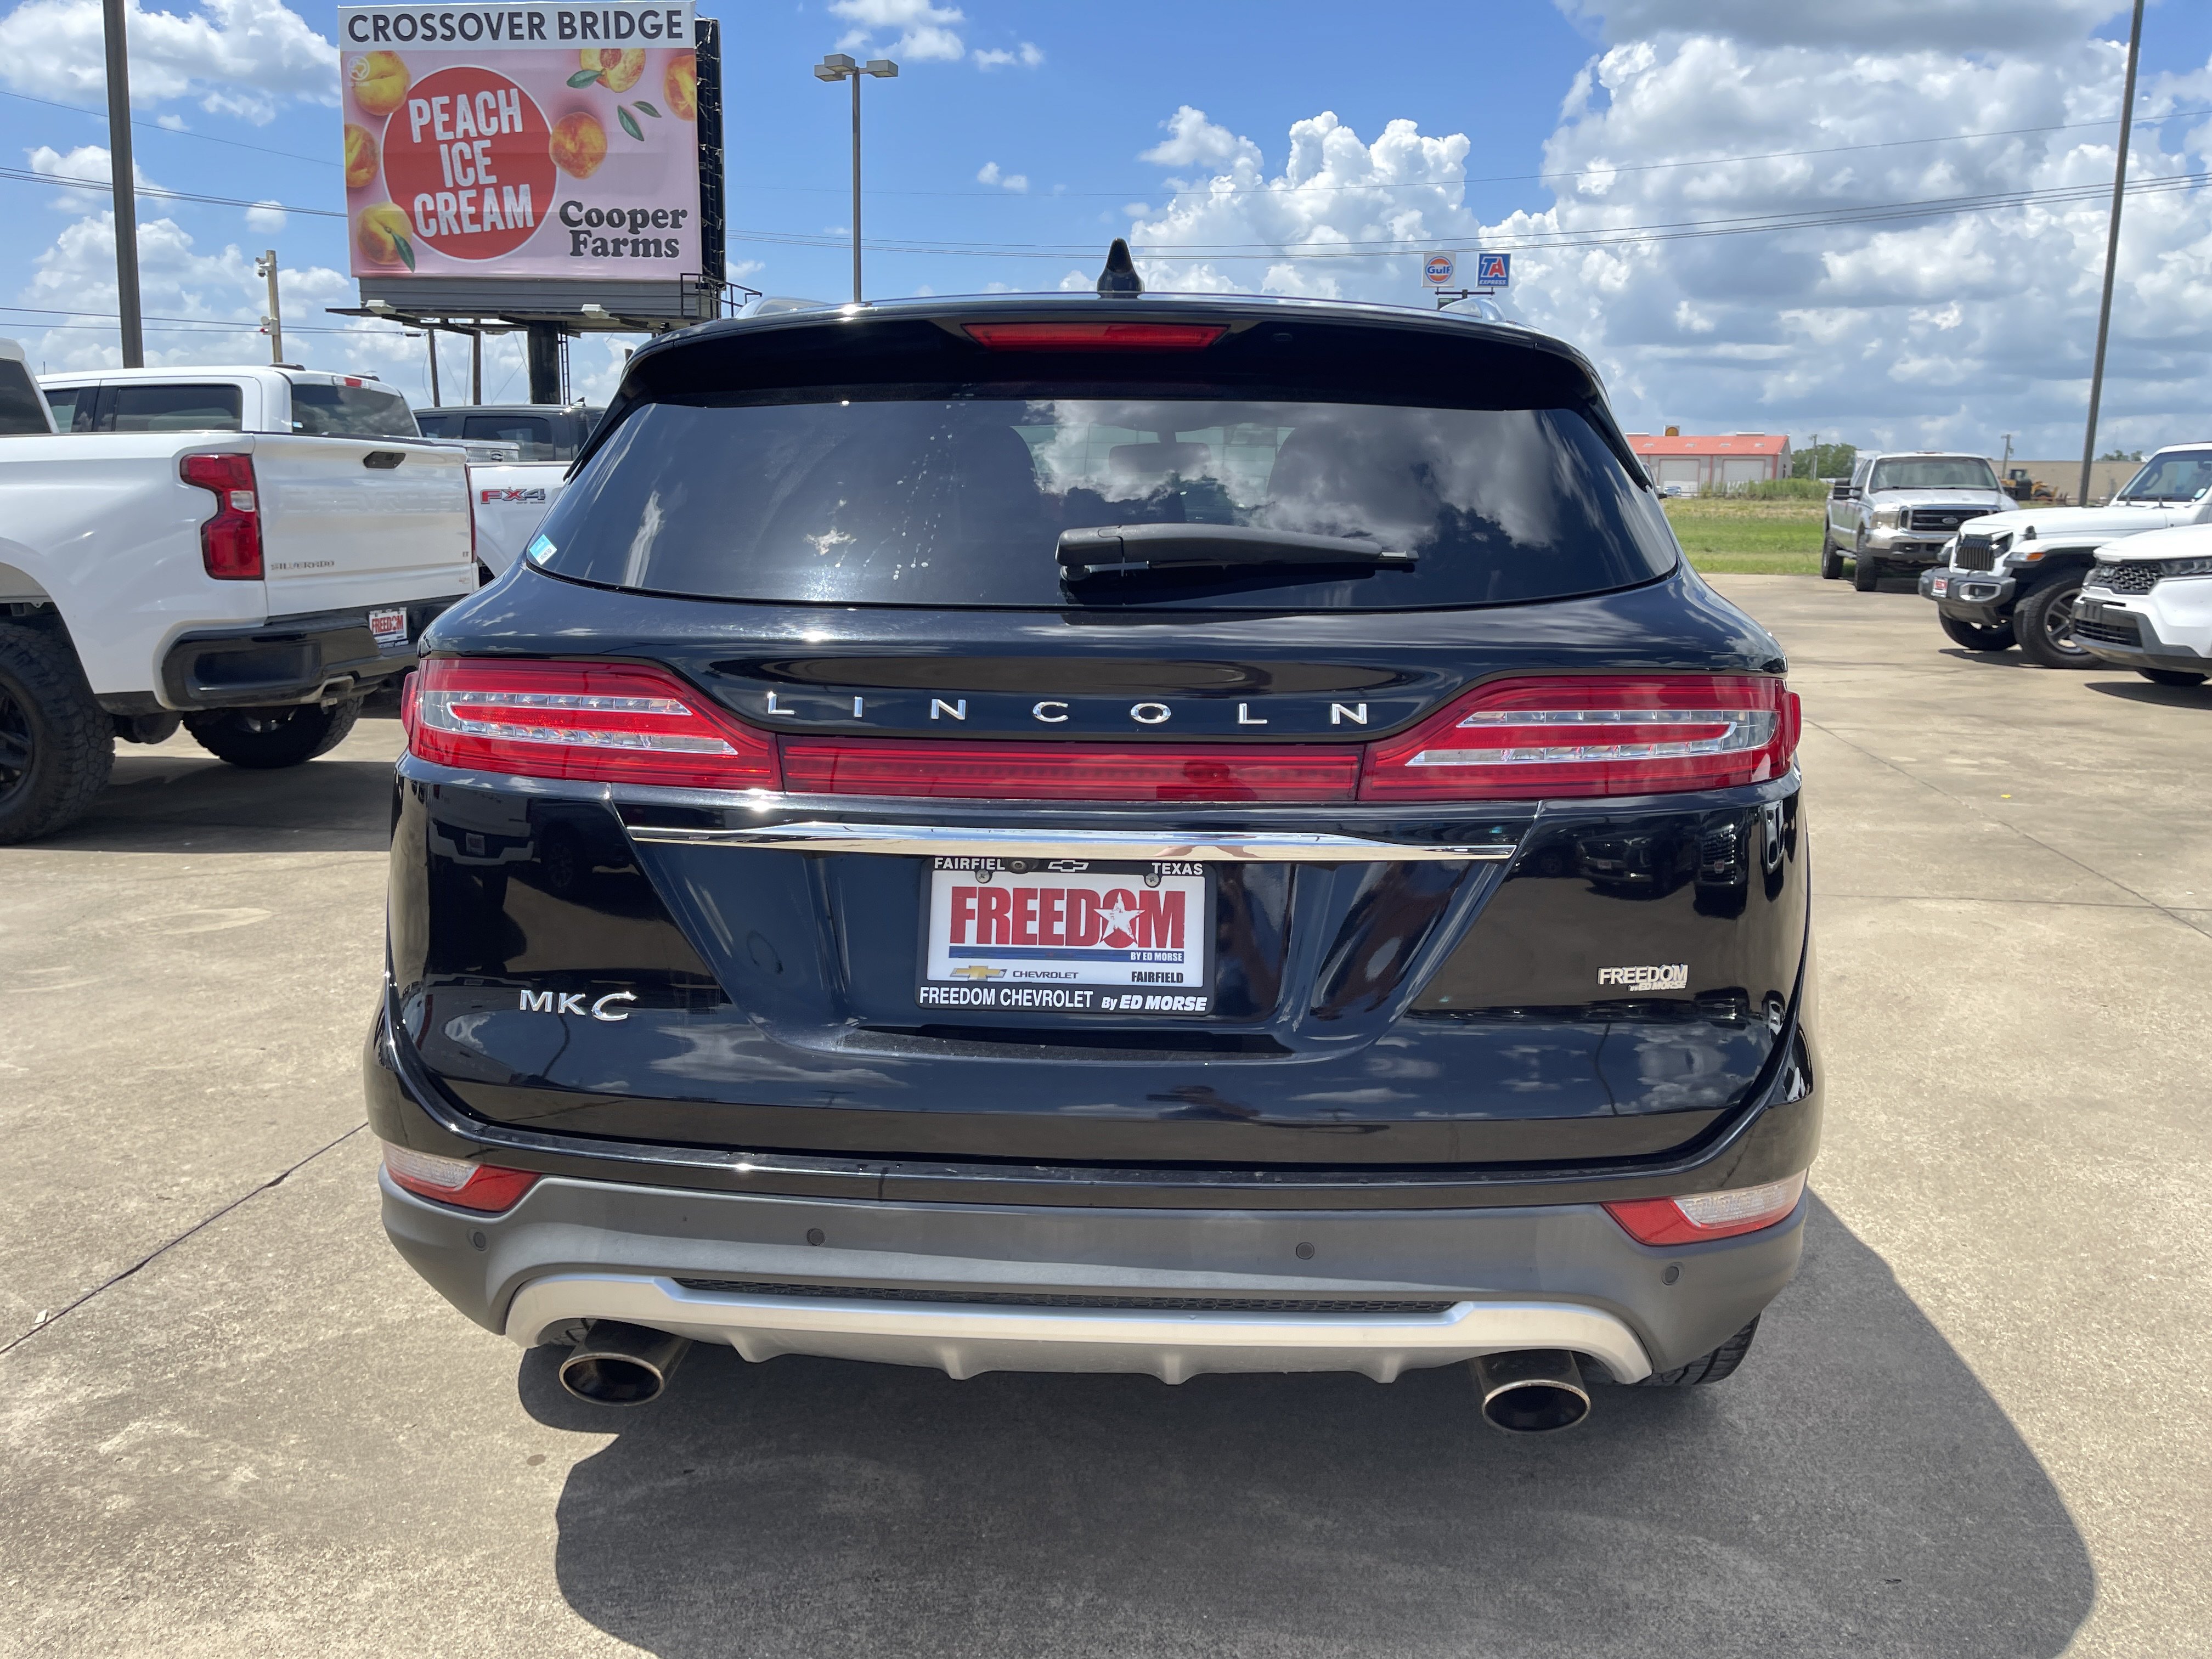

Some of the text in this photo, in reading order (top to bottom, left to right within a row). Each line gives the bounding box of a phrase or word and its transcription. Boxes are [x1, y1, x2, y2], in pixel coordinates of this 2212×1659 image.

[348, 10, 683, 42] CROSSOVER BRIDGE
[409, 88, 523, 143] PEACH
[439, 140, 497, 188] ICE
[414, 184, 534, 238] CREAM
[559, 200, 687, 233] Cooper
[569, 230, 679, 258] Farms
[1427, 266, 1451, 274] Gulf
[1481, 256, 1506, 278] TA
[480, 488, 545, 504] FX4
[768, 691, 1368, 724] LINCOLN
[934, 857, 1006, 870] FAIRFIEL
[1152, 862, 1203, 876] TEXAS
[950, 886, 1185, 949] FREEDOM
[1131, 952, 1182, 962] BY ED MORSE
[1013, 970, 1079, 979] CHEVROLET
[1131, 971, 1183, 983] FAIRFIELD
[1598, 964, 1689, 985] FREEDOM
[520, 990, 637, 1021] MKC
[919, 987, 1207, 1011] FREEDOM CHEVROLET By ED MORSE
